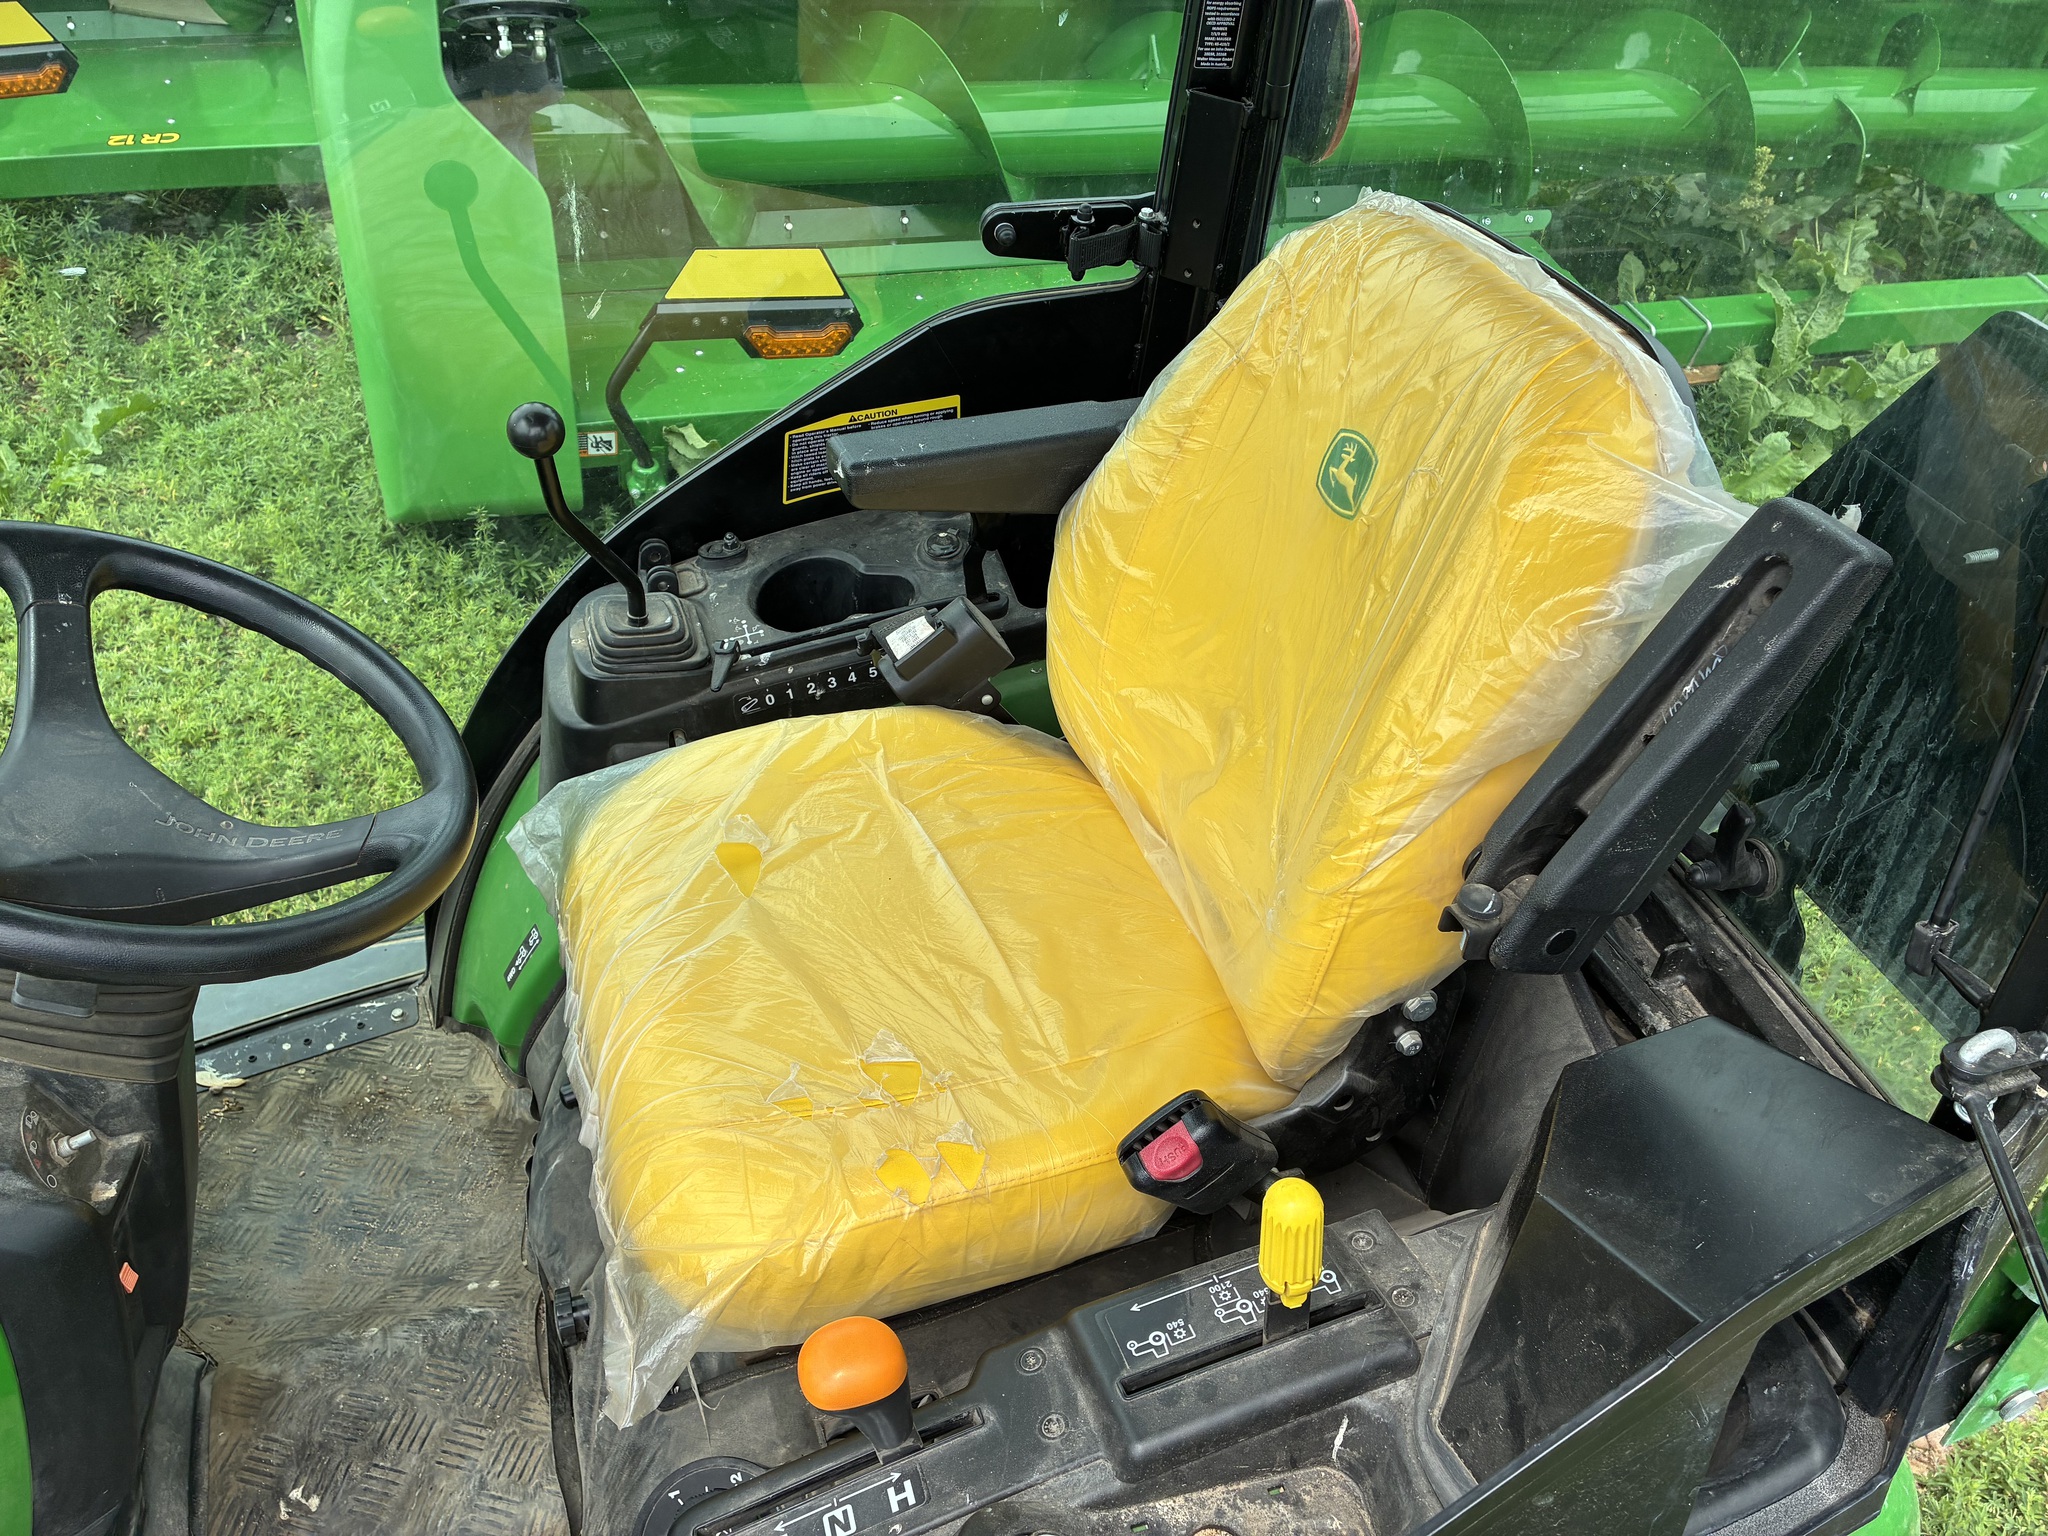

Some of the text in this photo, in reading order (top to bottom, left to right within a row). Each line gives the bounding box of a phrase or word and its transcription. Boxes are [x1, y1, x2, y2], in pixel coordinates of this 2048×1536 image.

[107, 132, 181, 146] CR 12
[857, 409, 898, 421] CAUTION
[765, 666, 878, 706] 0 1 2 3 4 5
[155, 816, 343, 848] JOHN DEERE
[1159, 1143, 1187, 1166] PUSH
[1208, 1280, 1232, 1294] 2100
[1166, 1318, 1185, 1331] 540
[886, 1478, 917, 1513] H
[825, 1507, 854, 1536] N
